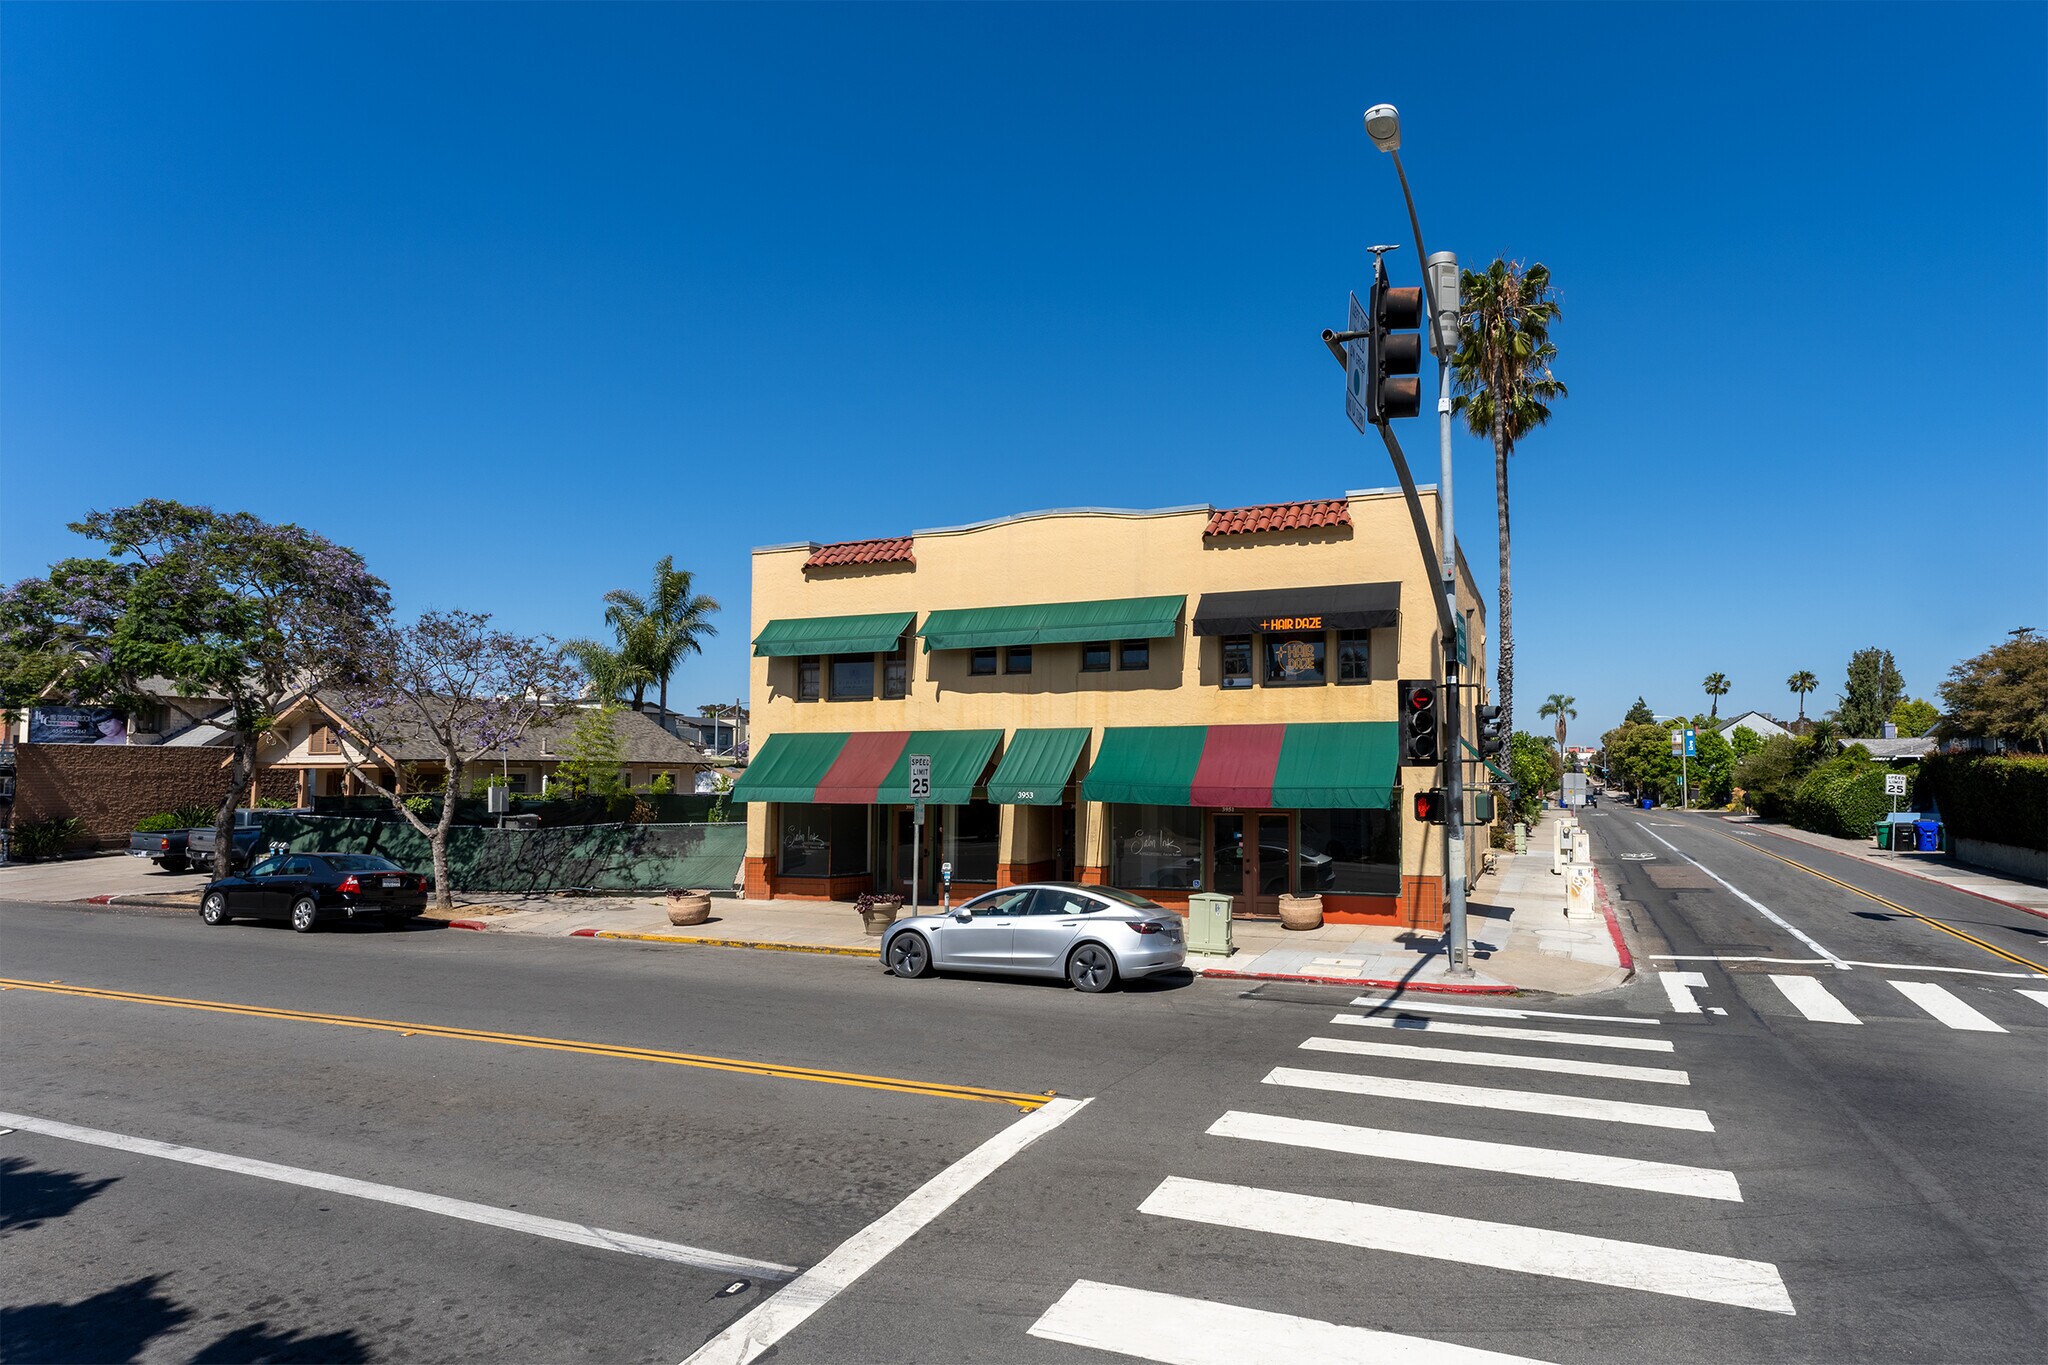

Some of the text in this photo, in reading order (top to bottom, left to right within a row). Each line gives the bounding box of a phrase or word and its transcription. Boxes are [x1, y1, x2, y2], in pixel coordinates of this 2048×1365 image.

[1271, 617, 1322, 630] HAIR DAZE
[1287, 644, 1315, 658] HAIR
[1287, 657, 1315, 670] DAZE
[911, 758, 930, 766] SPEED
[912, 778, 929, 794] 25
[1888, 785, 1904, 794] 25
[1017, 791, 1034, 799] 3953
[1130, 829, 1156, 855] Salon
